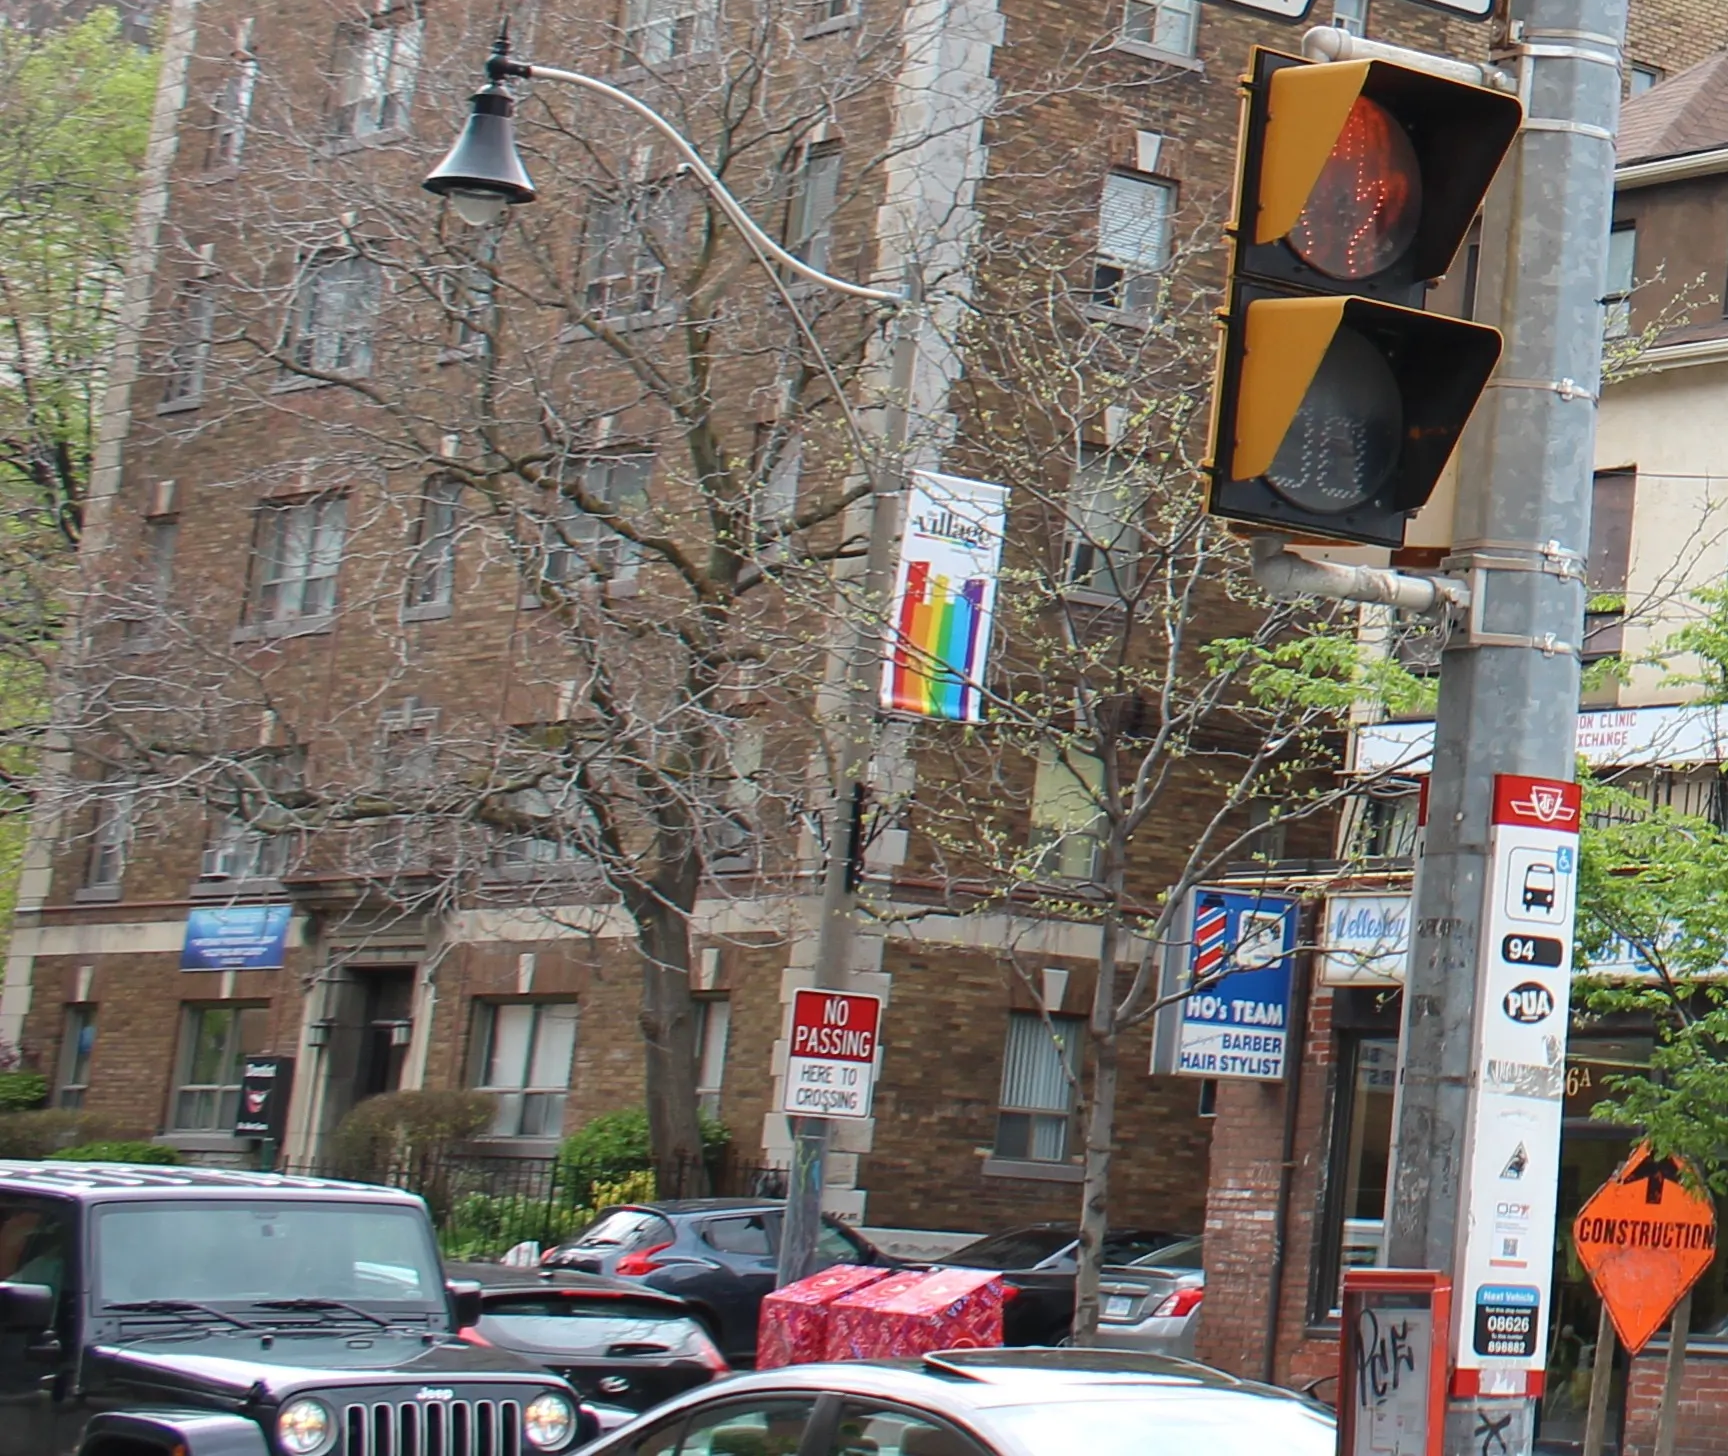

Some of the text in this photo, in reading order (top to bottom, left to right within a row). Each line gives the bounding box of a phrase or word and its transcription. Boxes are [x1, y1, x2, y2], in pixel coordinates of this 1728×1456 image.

[1600, 712, 1637, 728] CLINIC
[1577, 731, 1628, 747] XCHANGE
[1509, 938, 1535, 961] 94
[823, 999, 849, 1026] NO
[1187, 996, 1284, 1026] HO's TEAM
[1507, 990, 1550, 1019] PUA
[795, 1025, 871, 1057] PASSING
[1222, 1033, 1282, 1054] BARBER
[801, 1064, 858, 1085] HERE TO
[1180, 1051, 1281, 1075] HAIR STYLIST
[1566, 1067, 1592, 1096] 6A
[796, 1088, 858, 1110] CROSSING
[1579, 1217, 1714, 1250] CONSTRUCTION
[1487, 1316, 1530, 1333] 08626
[416, 1387, 454, 1401] Jeep
